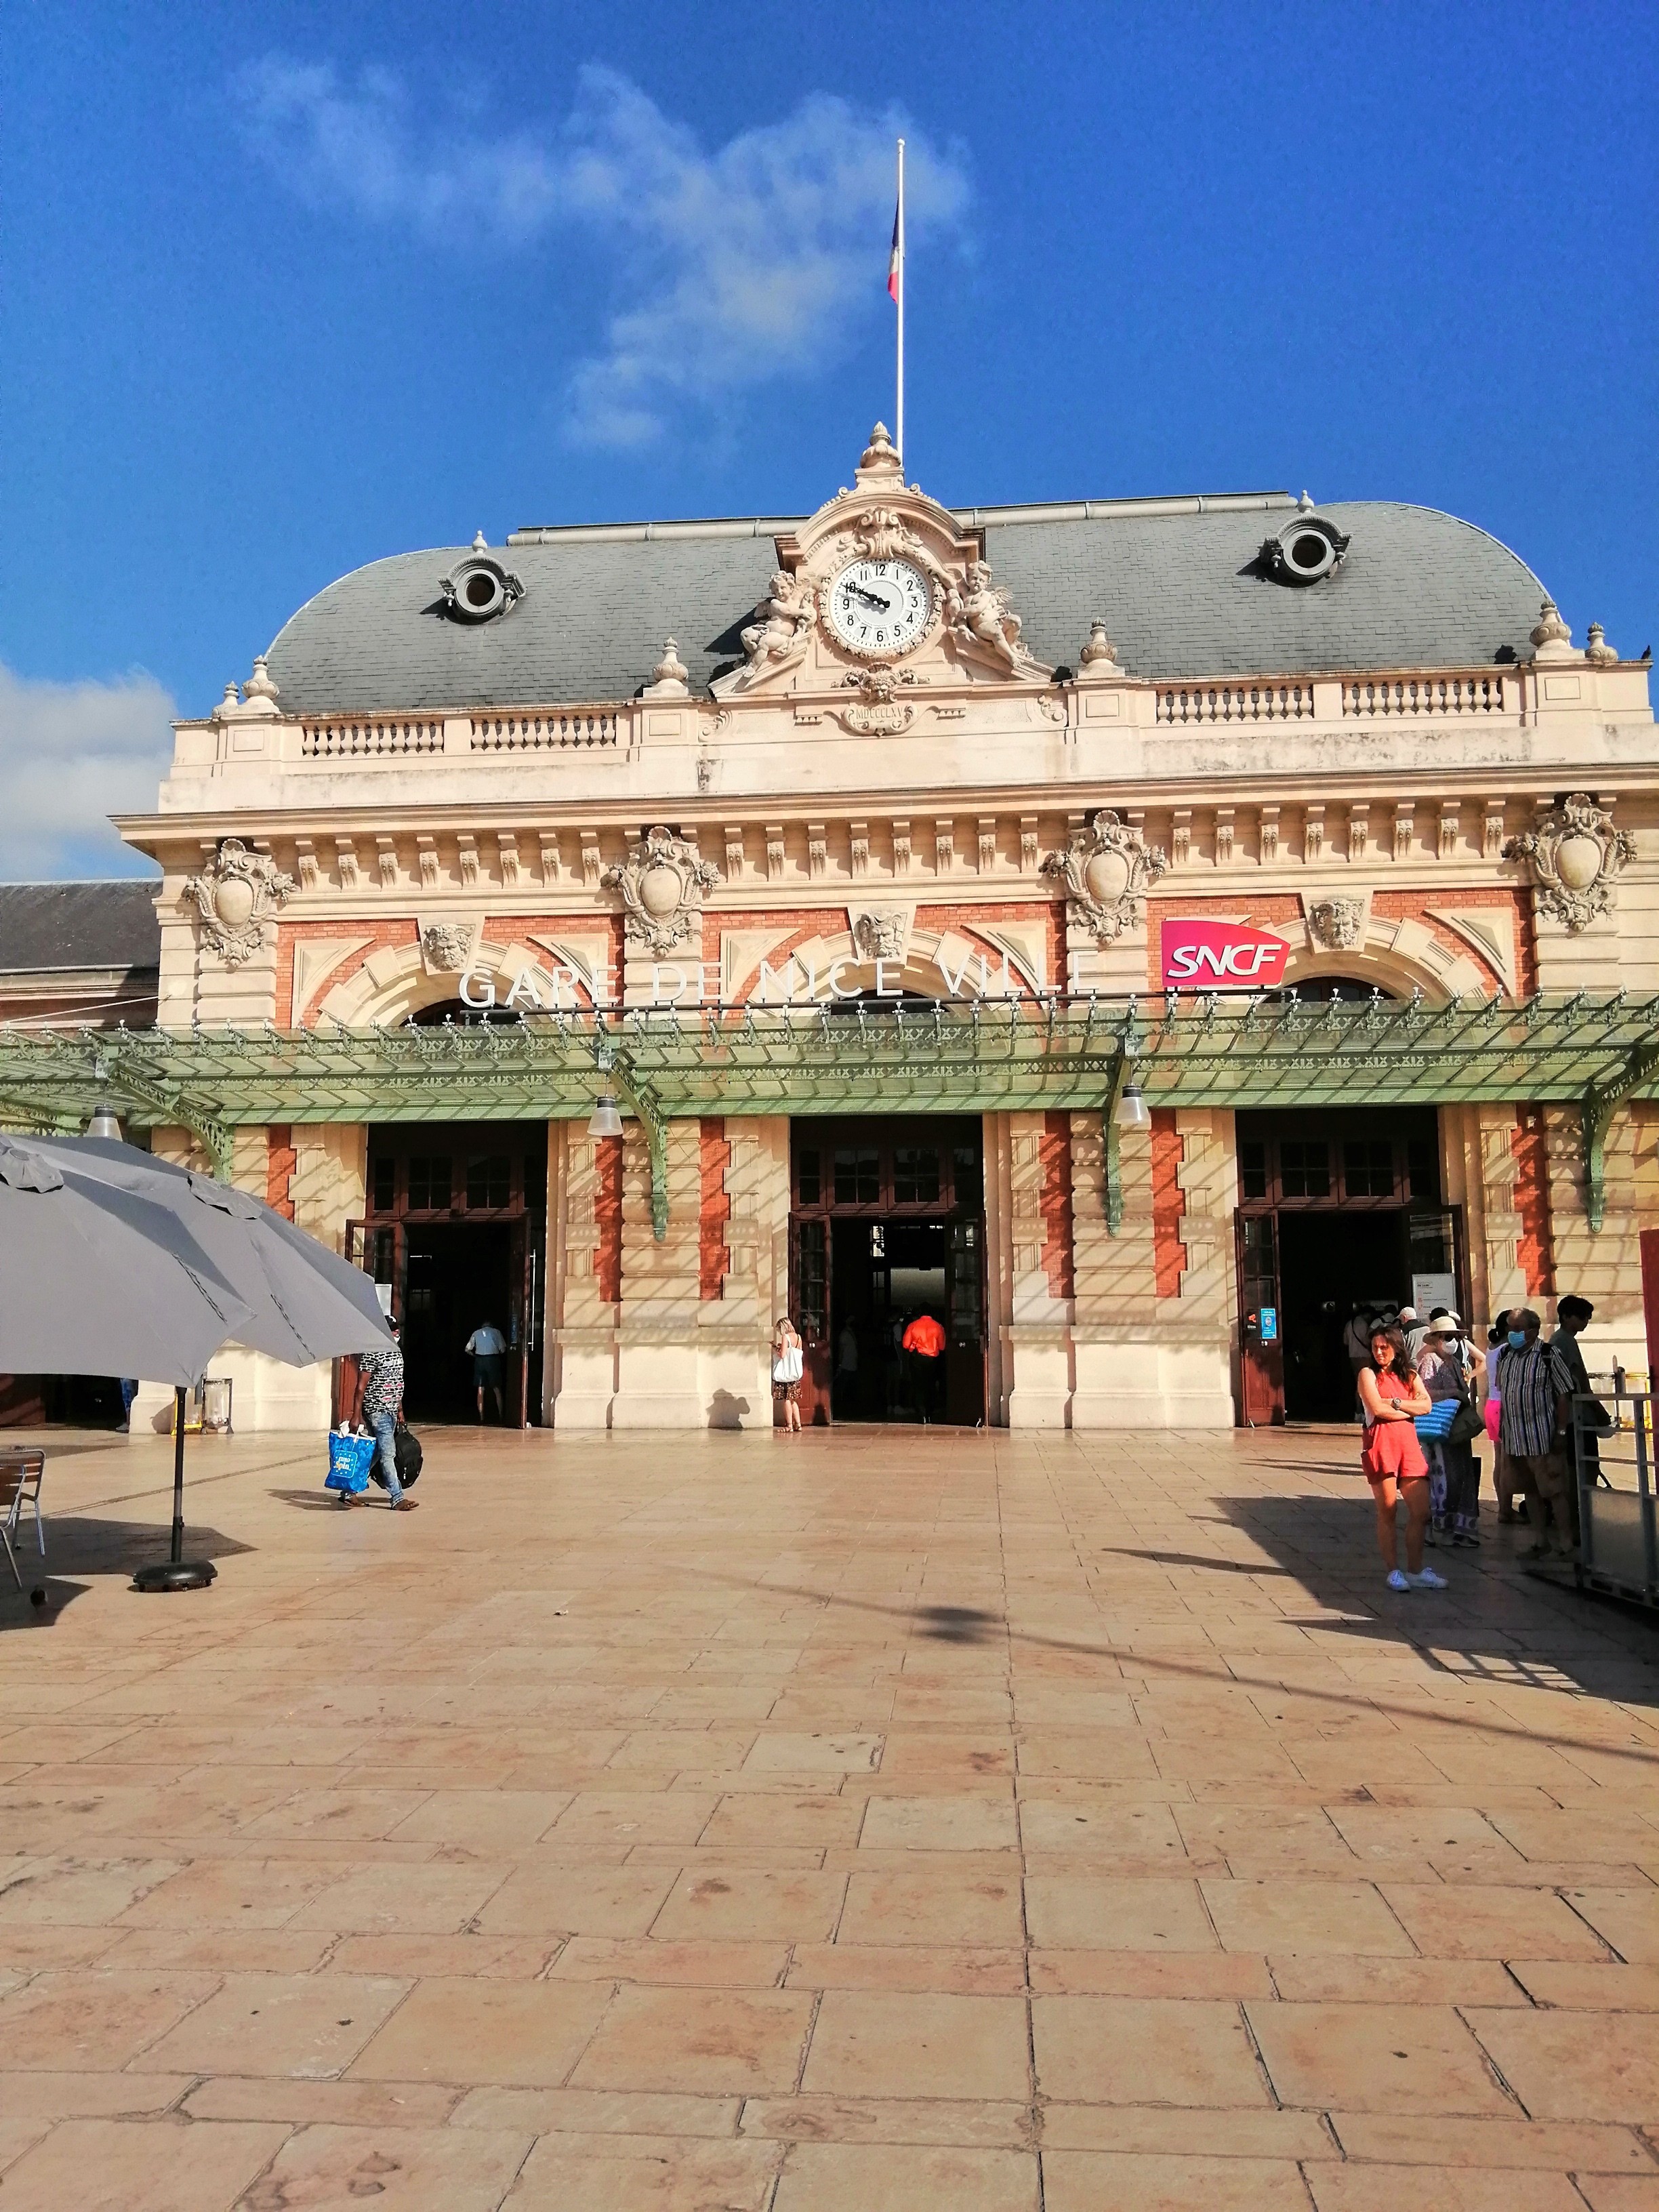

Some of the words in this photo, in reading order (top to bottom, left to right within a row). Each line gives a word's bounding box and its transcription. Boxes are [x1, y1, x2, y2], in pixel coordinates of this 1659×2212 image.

[860, 571, 867, 581] 11
[876, 564, 886, 576] 12
[896, 569, 899, 580] 1
[907, 580, 914, 592] 2
[842, 598, 850, 610] 9
[912, 596, 918, 608] 3
[847, 615, 854, 626] 8
[906, 612, 914, 624] 4
[860, 626, 867, 638] 7
[876, 630, 884, 642] 6
[894, 625, 901, 637] 5
[1167, 943, 1283, 978] SNCF
[459, 964, 619, 1008] GARE
[653, 960, 722, 1002] DE
[760, 956, 903, 999] NICE
[936, 950, 1101, 995] VILLE
[336, 1460, 349, 1471] Spin
